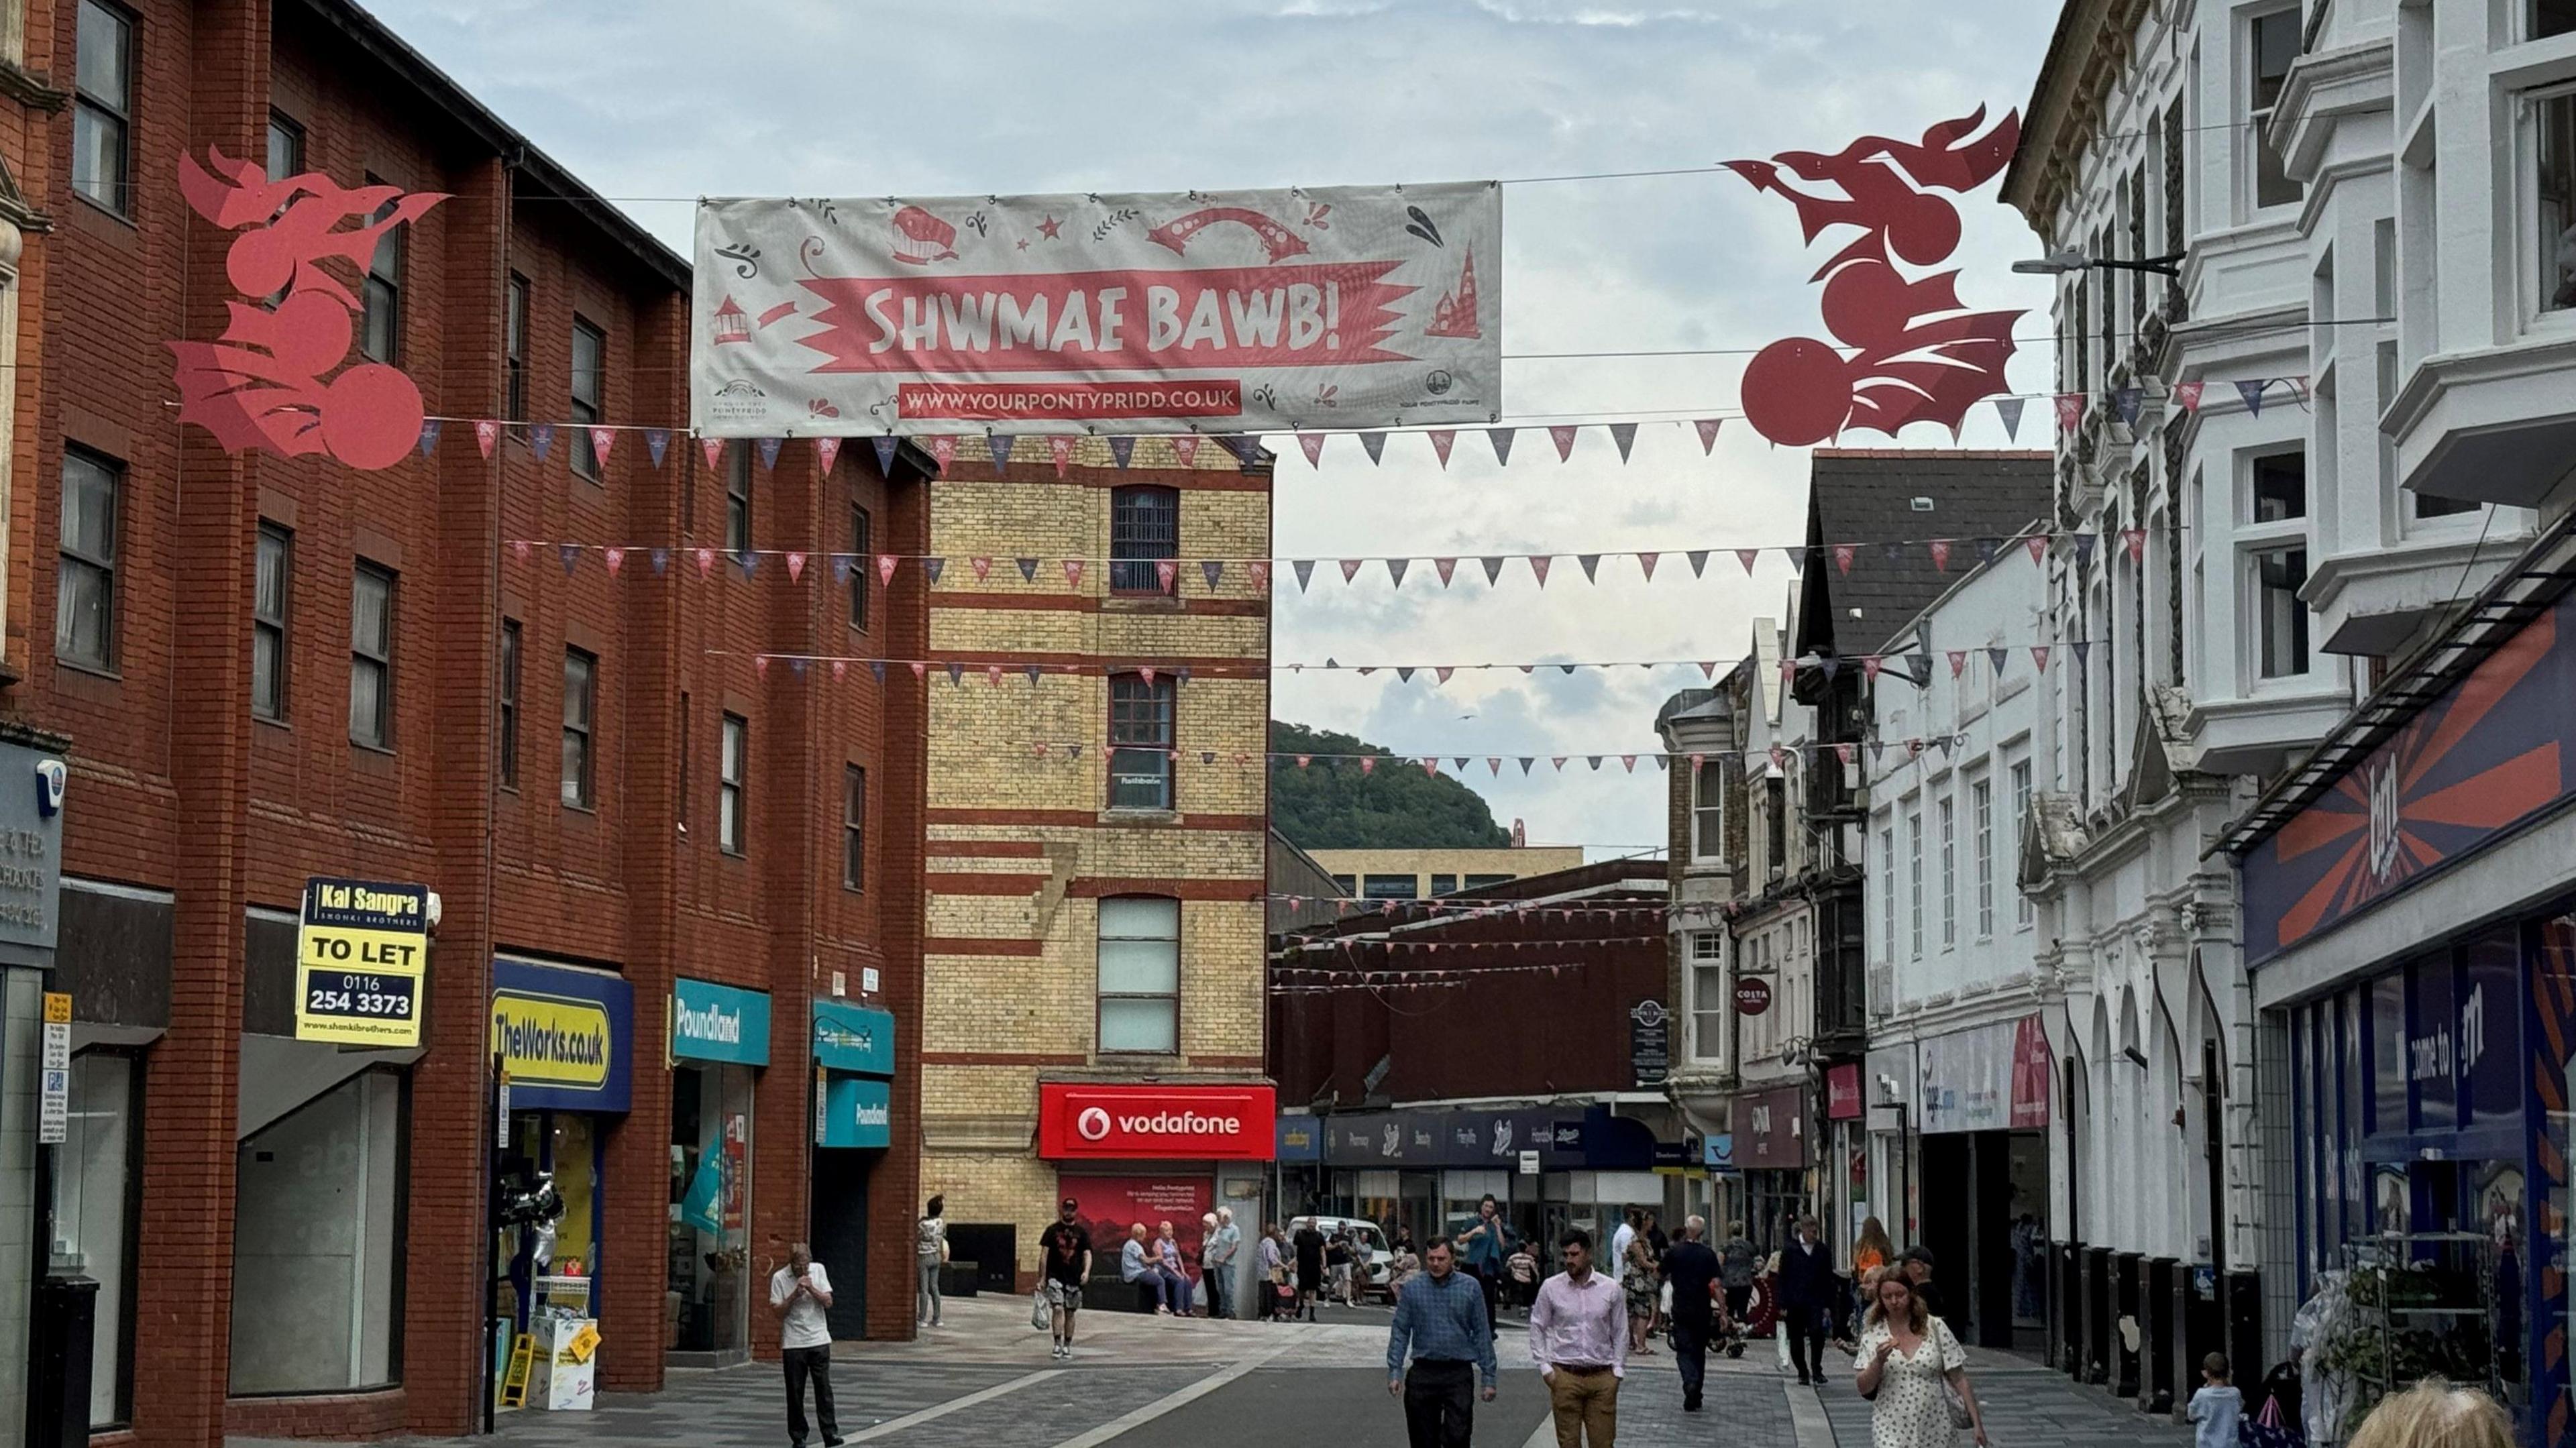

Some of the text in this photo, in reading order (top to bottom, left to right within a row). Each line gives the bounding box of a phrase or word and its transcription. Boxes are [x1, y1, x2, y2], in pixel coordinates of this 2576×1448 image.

[864, 280, 1340, 354] SHWMAE BAWB!
[906, 390, 1235, 410] WWW.YOURPONTYPRIDD.CO.UK
[322, 885, 419, 916] Kal Sangra
[312, 936, 417, 966] TO LET
[343, 974, 380, 991] 0116
[1737, 989, 1768, 999] COSTA
[309, 990, 410, 1015] 254 3373
[676, 997, 741, 1044] Poundland
[496, 1011, 604, 1066] TheWorks.co.uk
[2437, 1022, 2449, 1076] to
[1118, 1110, 1240, 1134] vodafone
